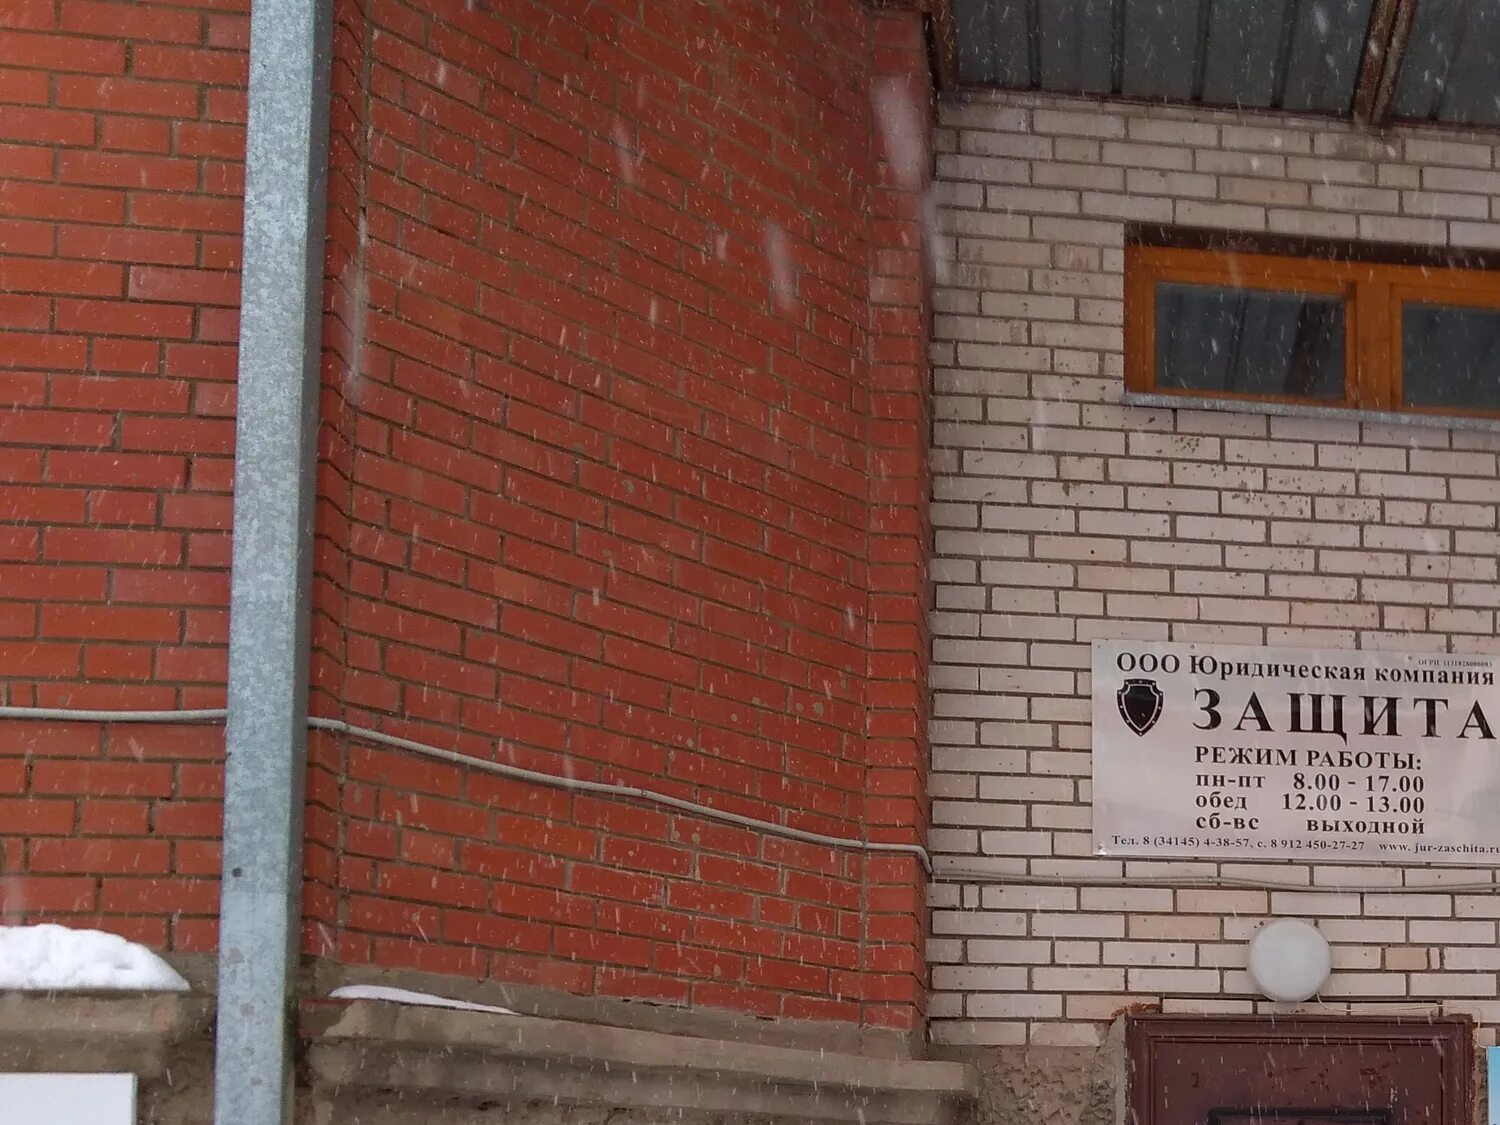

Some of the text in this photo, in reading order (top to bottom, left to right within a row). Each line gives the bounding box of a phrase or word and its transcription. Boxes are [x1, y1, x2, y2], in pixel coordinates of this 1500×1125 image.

[1116, 652, 1494, 685] ООО Юридическая компания
[1192, 688, 1497, 746] ЗАЩИТА
[1195, 746, 1422, 770] РЕЖИМ РАБОТЫ:
[1195, 773, 1266, 788] пн-пт
[1293, 773, 1340, 791] 8.00
[1366, 775, 1425, 793] 17.00
[1195, 791, 1248, 810] обед
[1282, 793, 1342, 812] 12.00
[1366, 796, 1425, 814] 13.00
[1195, 812, 1425, 835] сб-вс выходной
[1111, 835, 1139, 846] Тел.
[1142, 836, 1150, 846] 8
[1153, 836, 1200, 849] (34145)
[1203, 837, 1254, 850] 4-38-57,
[1270, 839, 1277, 848] 8
[1281, 839, 1302, 849] 912
[1305, 840, 1365, 851] 450-27-27
[1379, 843, 1411, 852] www.
